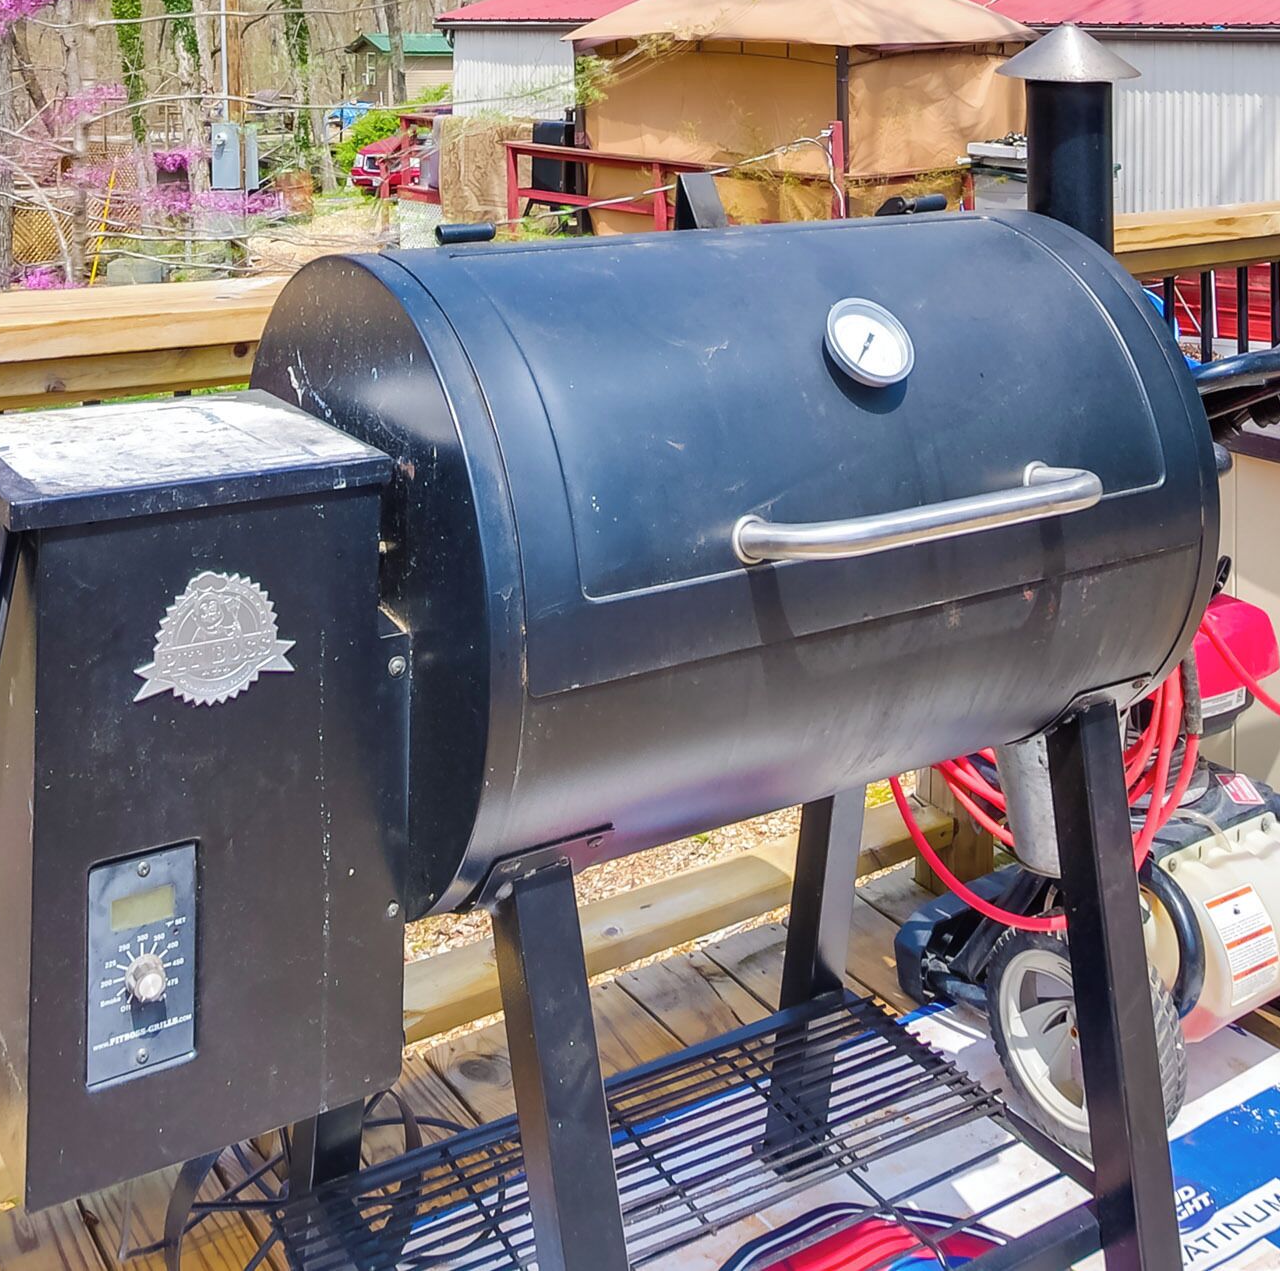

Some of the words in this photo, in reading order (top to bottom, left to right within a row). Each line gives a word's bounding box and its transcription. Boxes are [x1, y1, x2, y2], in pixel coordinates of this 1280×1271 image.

[161, 652, 203, 674] PIT
[212, 637, 271, 664] BOSS
[174, 916, 186, 926] SET
[136, 933, 149, 942] 300
[166, 940, 179, 950] 400
